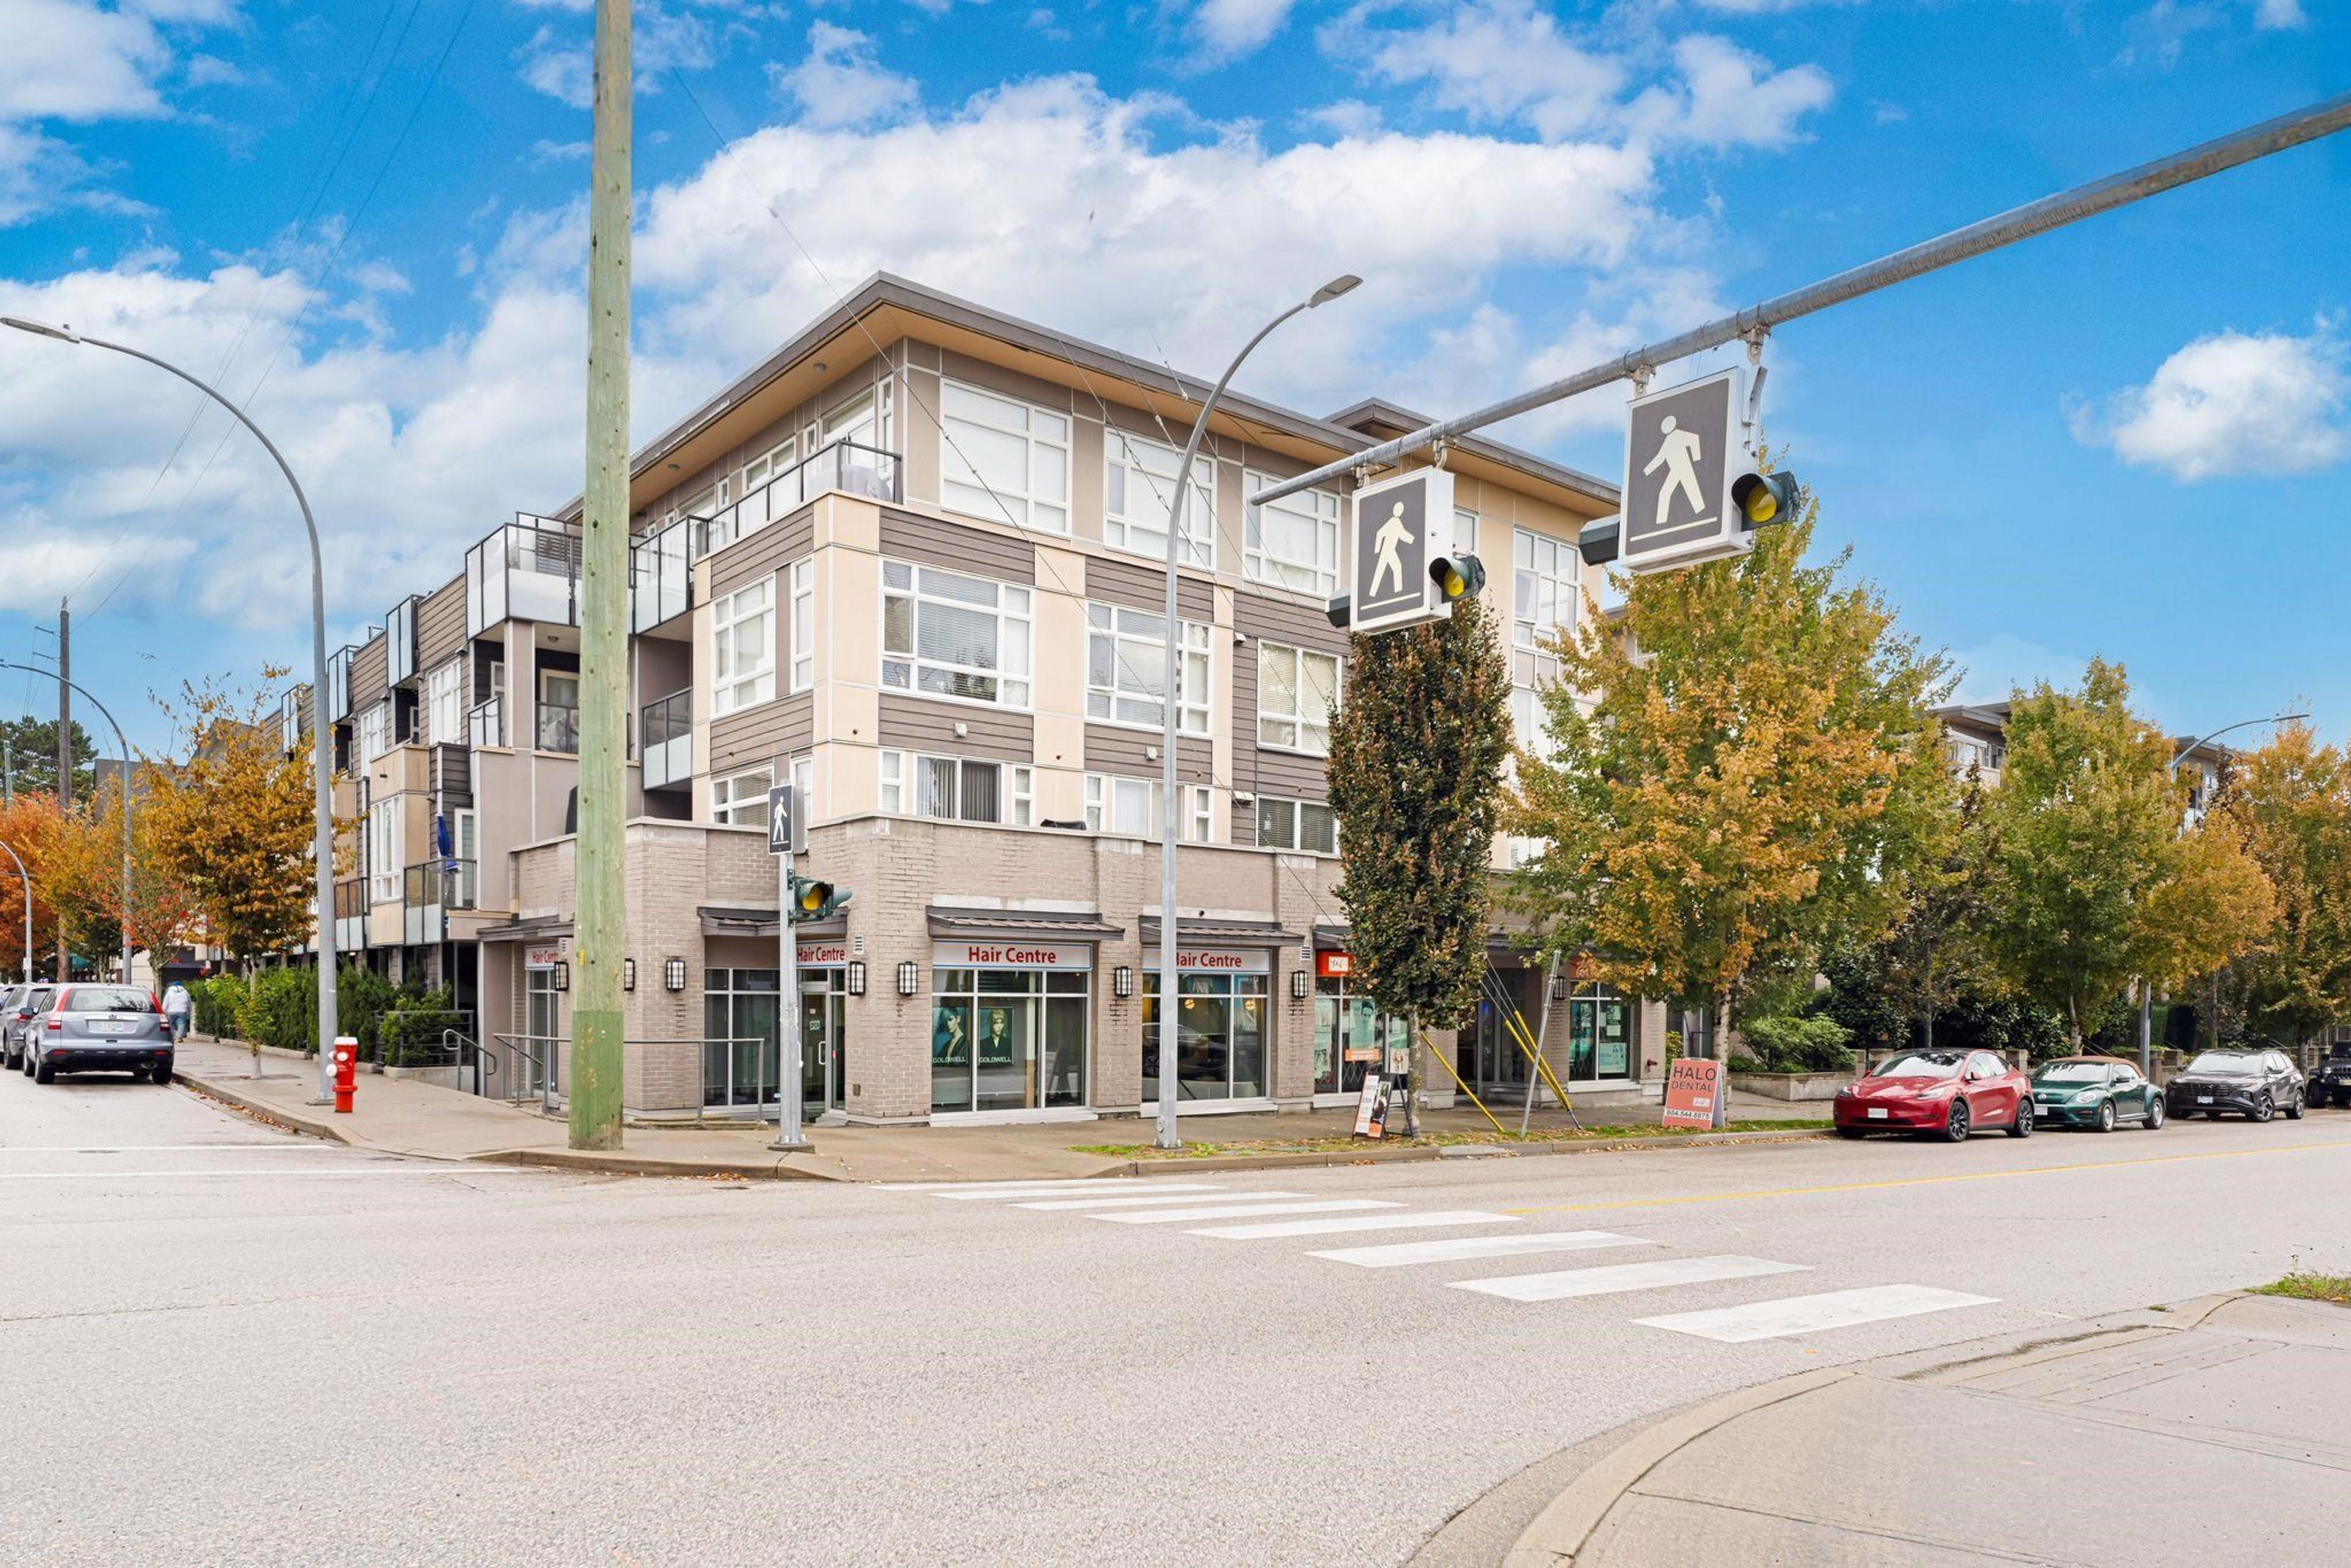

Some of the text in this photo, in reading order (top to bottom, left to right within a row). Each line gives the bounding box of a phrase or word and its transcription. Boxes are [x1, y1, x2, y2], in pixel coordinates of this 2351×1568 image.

[532, 950, 543, 964] Hair
[797, 947, 845, 962] Hair Centre
[969, 947, 1056, 963] Hair Centre
[1200, 953, 1242, 967] Centre
[1673, 1066, 1715, 1081] HALO
[1671, 1081, 1714, 1092] DENTAL
